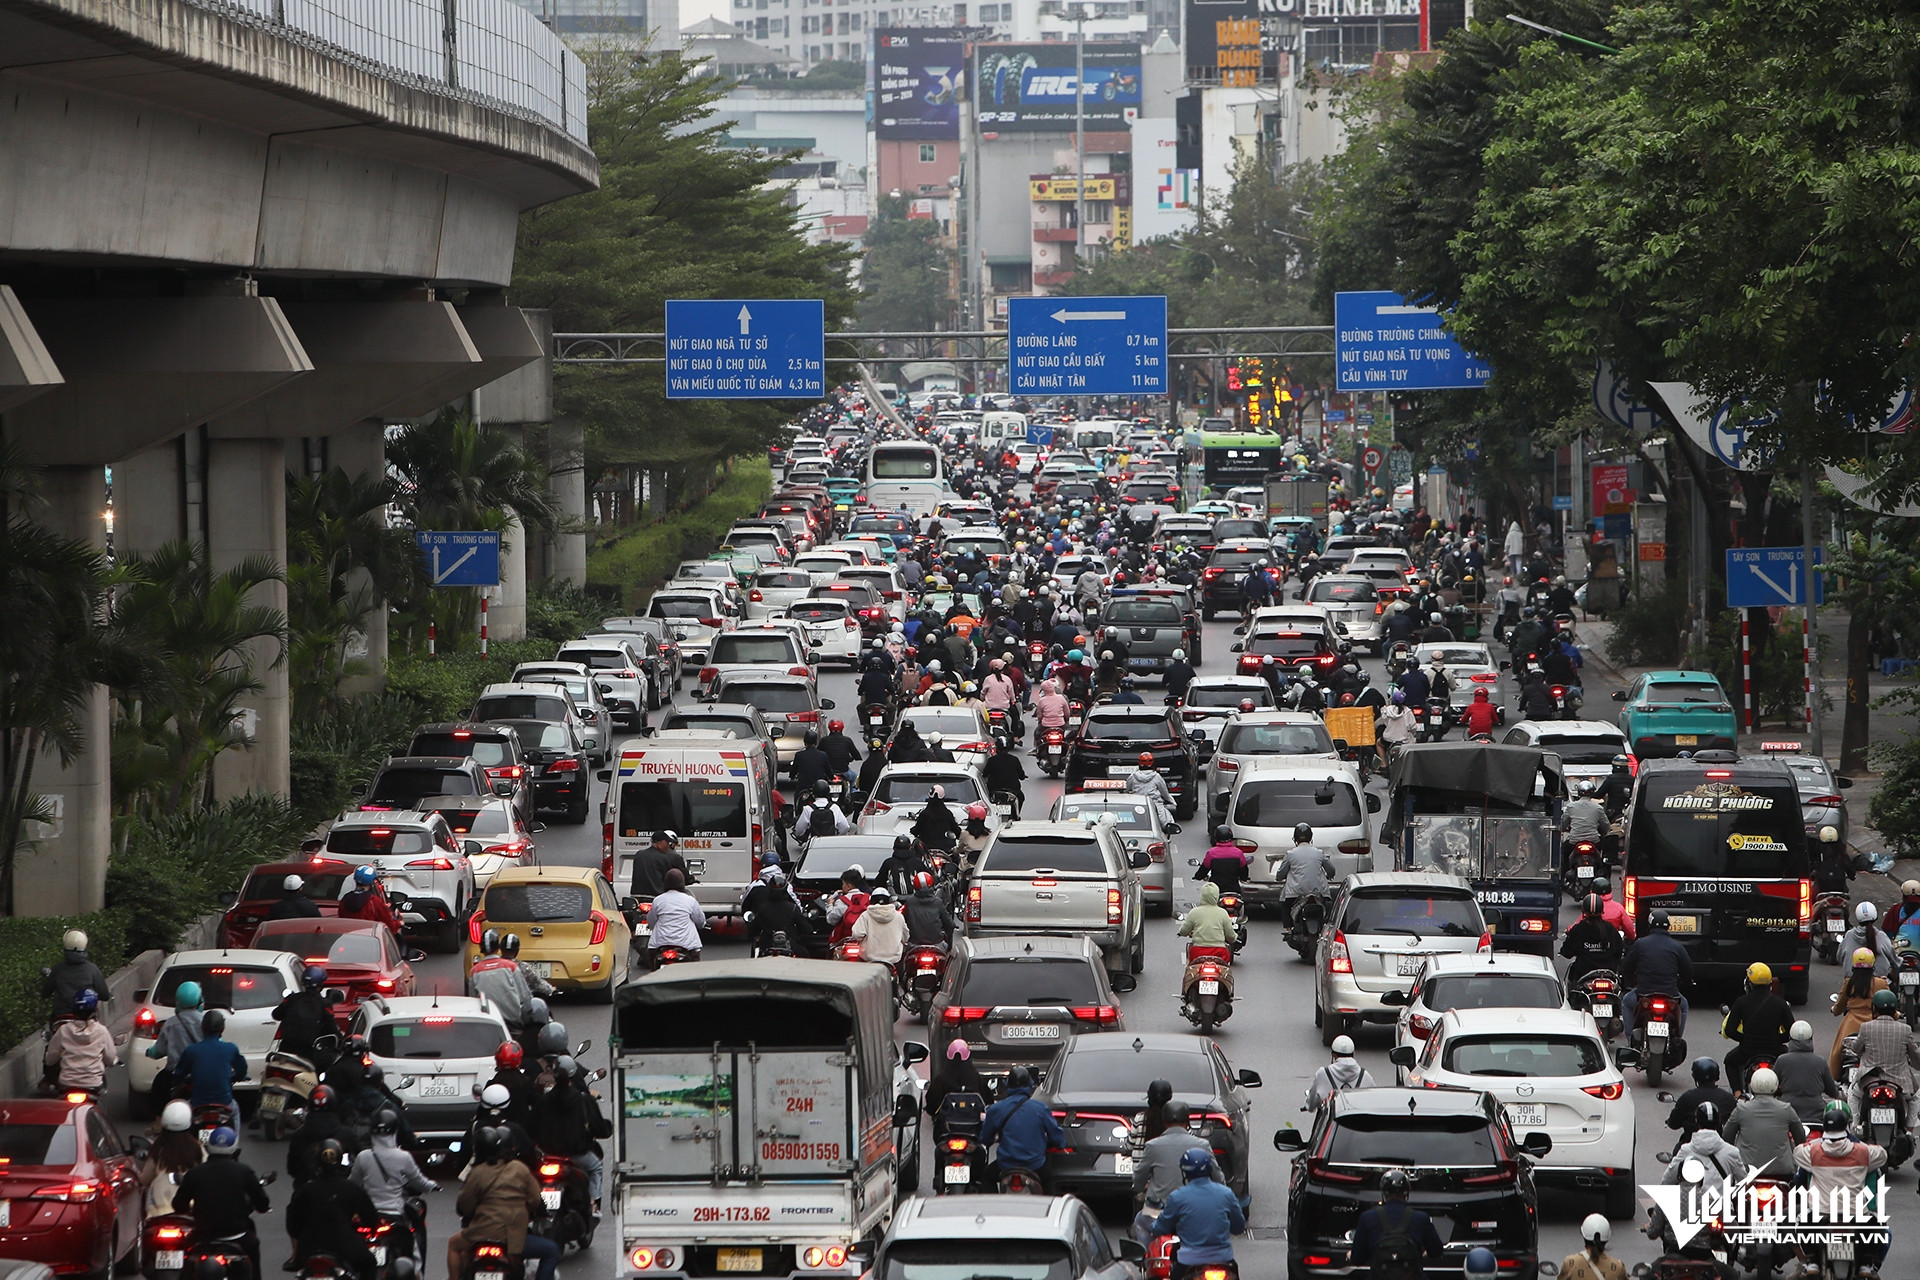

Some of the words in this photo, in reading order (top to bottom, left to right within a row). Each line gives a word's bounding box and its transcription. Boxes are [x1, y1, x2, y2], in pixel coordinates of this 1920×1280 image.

[1027, 76, 1078, 95] IRC
[1222, 70, 1256, 87] LAN
[1017, 333, 1048, 347] ĐƯỜNG
[1052, 332, 1077, 347] LÁNG
[1144, 335, 1158, 346] km
[1341, 327, 1373, 342] ĐƯỜNG
[1377, 326, 1415, 341] TRƯỜNG
[670, 336, 688, 350] NÚT
[691, 339, 712, 350] GIAO
[716, 337, 735, 350] NGÃ
[739, 338, 752, 350] TƯ
[756, 335, 768, 350] SỞ
[1017, 353, 1036, 368] NÚT
[1038, 356, 1059, 367] GIAO
[1063, 352, 1081, 367] CẦU
[1085, 352, 1105, 367] GIẤY
[1135, 355, 1141, 366] 5
[1144, 355, 1159, 366] km
[1342, 348, 1360, 362] NÚT
[1363, 350, 1384, 361] GIAO
[1387, 348, 1406, 361] NGÃ
[1409, 348, 1422, 360] TƯ
[1425, 348, 1450, 362] VỌNG
[670, 355, 688, 370] NÚT
[691, 359, 712, 370] GIAO
[716, 356, 722, 370] Ô
[726, 358, 744, 372] CHỢ
[748, 355, 767, 370] DỪA
[806, 359, 820, 370] km
[671, 377, 688, 390] VĂN
[691, 374, 714, 390] MIẾU
[717, 374, 741, 390] QUỐC
[744, 375, 756, 390] TỬ
[759, 375, 782, 390] GIÁM
[806, 378, 820, 389] km
[1017, 373, 1036, 388] CẦU
[1039, 374, 1063, 389] NHẬT
[1068, 374, 1086, 387] TÂN
[1132, 375, 1141, 386] 11
[1144, 375, 1159, 386] km
[1342, 367, 1360, 383] CẦU
[1365, 367, 1386, 382] VĨNH
[1390, 369, 1408, 381] TUY
[1466, 368, 1472, 379] 8
[1476, 368, 1490, 378] km
[478, 536, 496, 544] CHINH
[1732, 552, 1744, 562] TÂY
[685, 763, 724, 775] HƯƠNG
[1684, 882, 1752, 893] LIMOUSINE
[1477, 891, 1515, 903] 840.84
[1746, 917, 1797, 926] 29G-013.06
[1404, 956, 1419, 965] 29A
[1009, 1025, 1058, 1037] 30G-415.20
[424, 1087, 455, 1095] 282.60
[786, 1097, 814, 1113] 24H
[1517, 1105, 1535, 1114] 30H
[762, 1143, 840, 1160] 0859031559
[694, 1207, 771, 1222] 29H-173.62
[730, 1249, 750, 1258] 29H
[722, 1258, 757, 1270] 173.62
